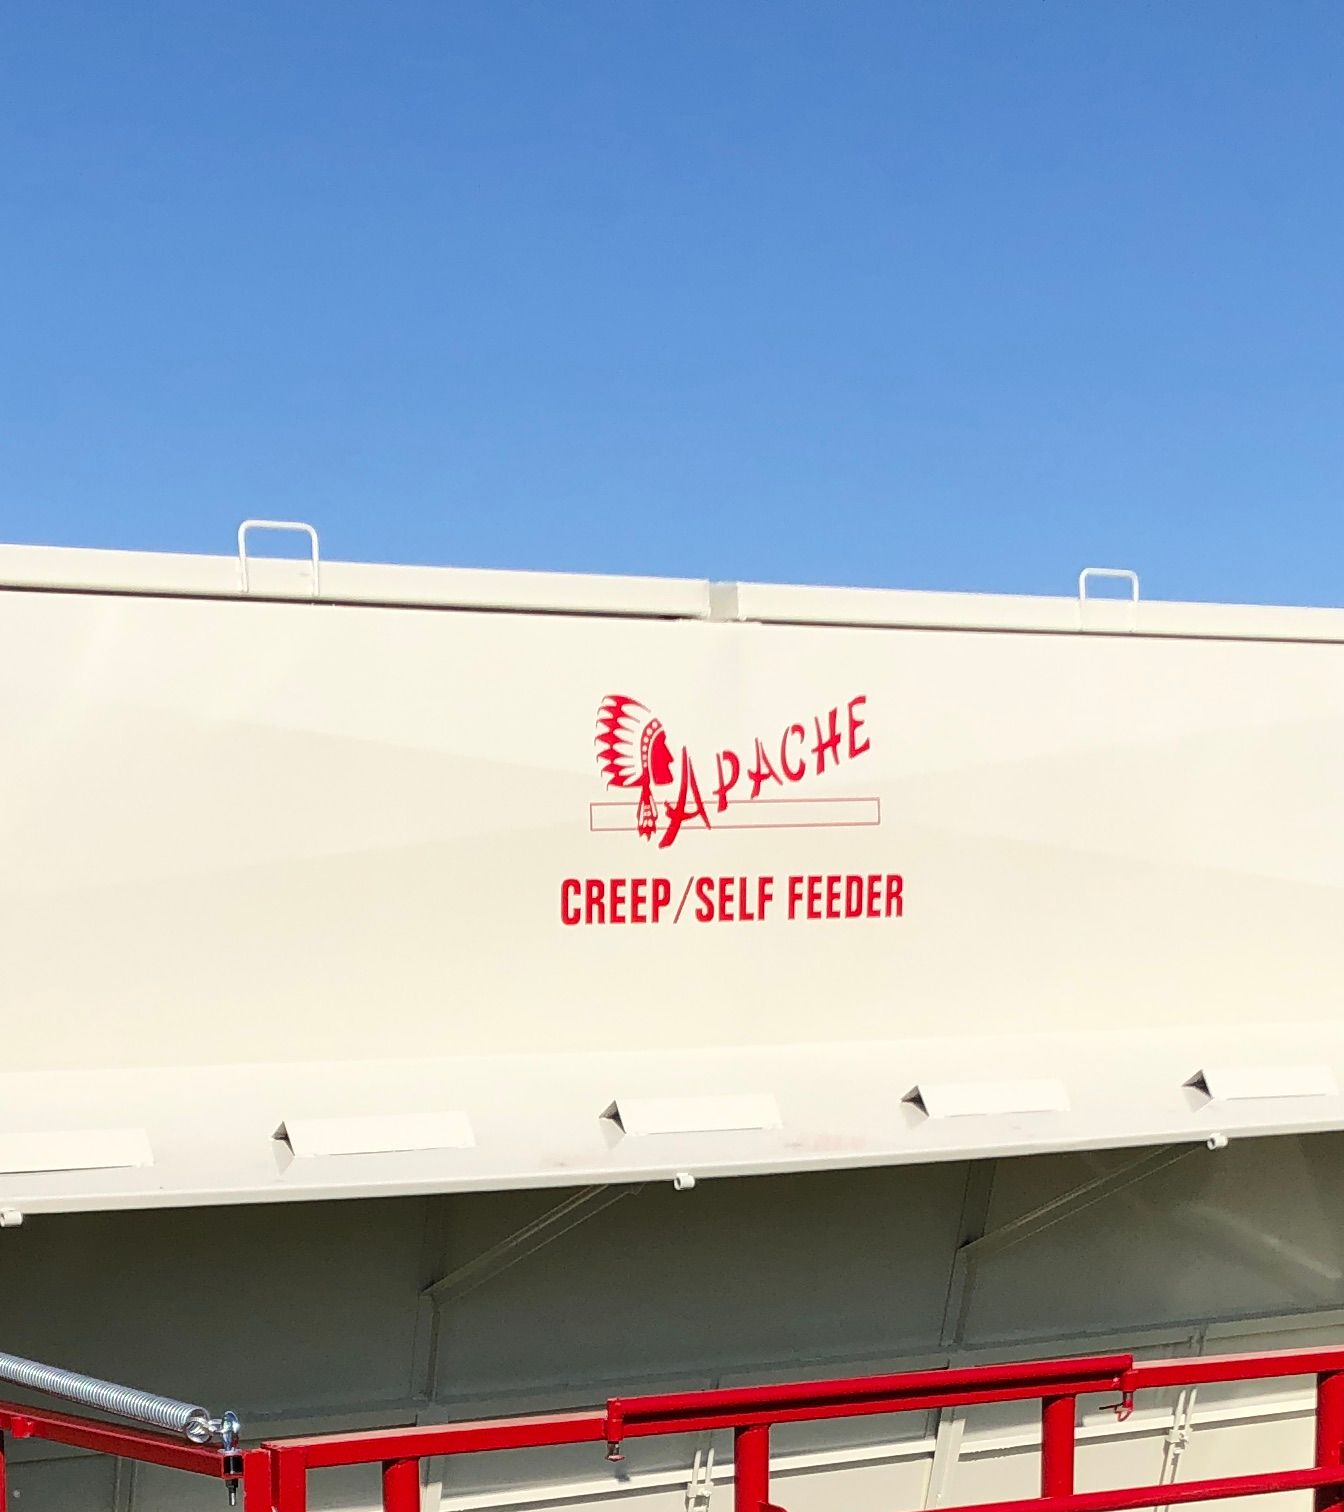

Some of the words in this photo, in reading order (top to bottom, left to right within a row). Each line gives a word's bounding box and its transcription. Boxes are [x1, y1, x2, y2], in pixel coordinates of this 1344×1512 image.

[658, 694, 871, 849] APACHE
[560, 874, 775, 926] CREEP/SELF
[787, 873, 905, 921] FEEDER
